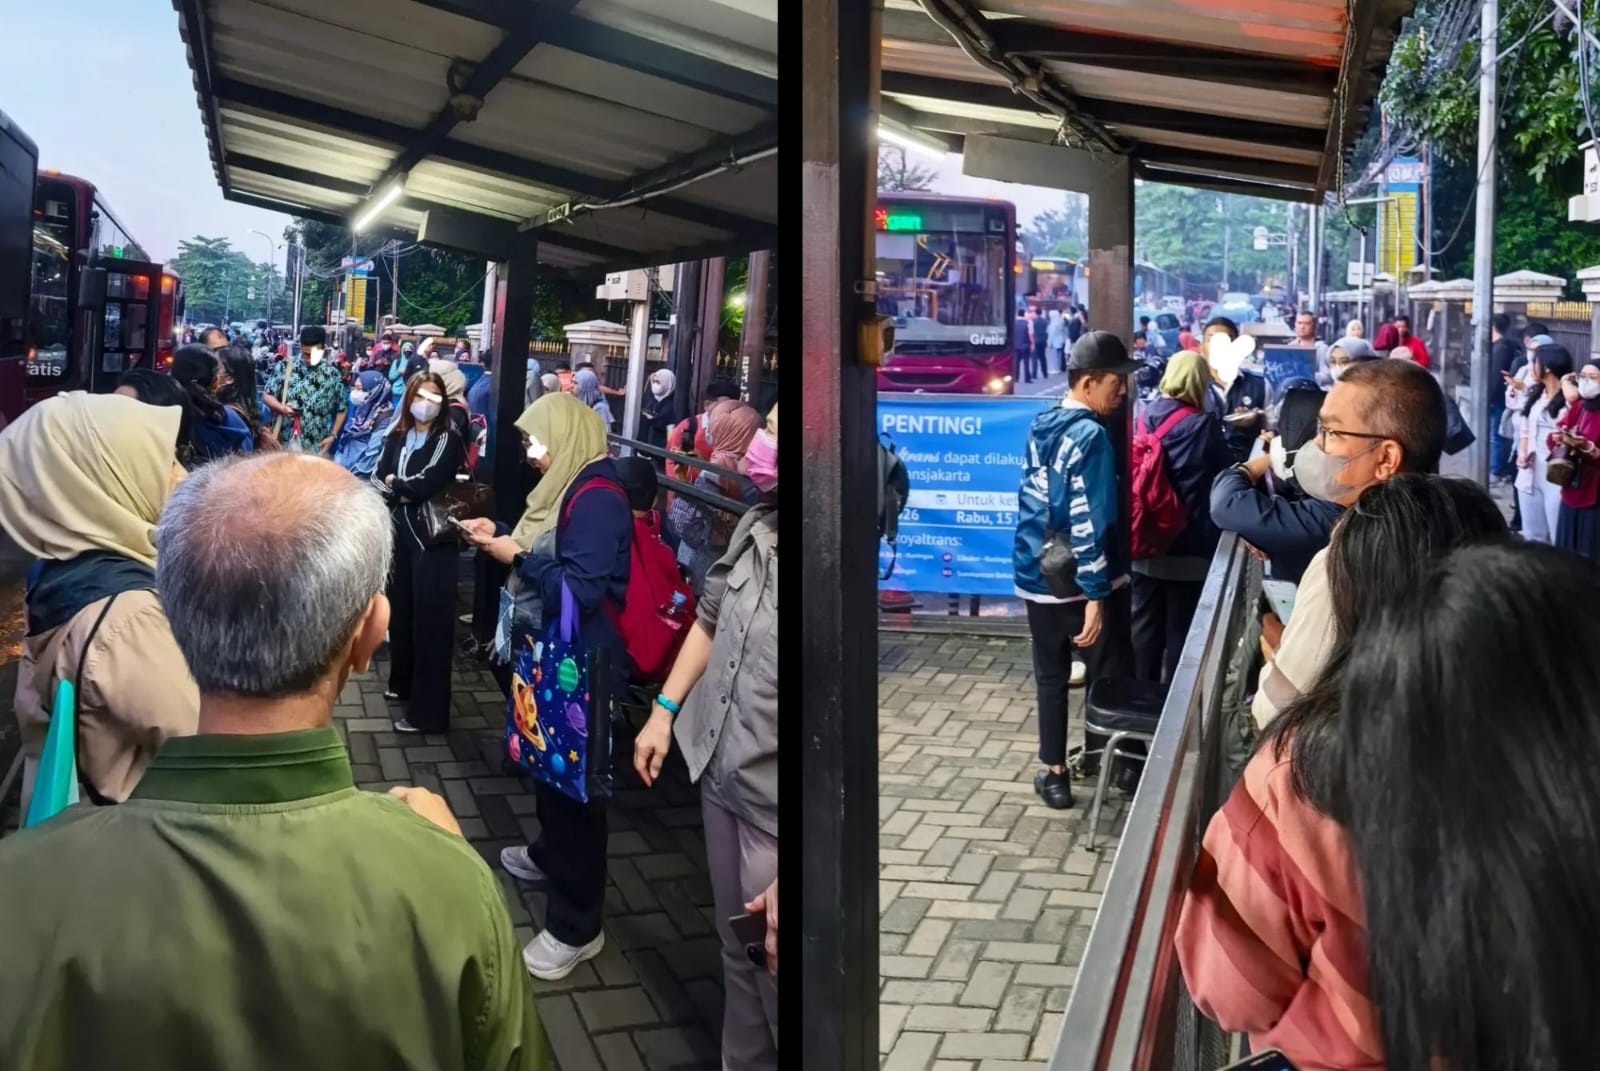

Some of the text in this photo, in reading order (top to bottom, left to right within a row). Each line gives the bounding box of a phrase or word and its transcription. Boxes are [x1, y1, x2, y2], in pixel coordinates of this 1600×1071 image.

[970, 333, 1005, 345] Gratis
[26, 362, 62, 377] atis
[882, 414, 982, 435] PENTING!
[944, 451, 980, 466] dapat
[984, 452, 1026, 465] dilaku
[957, 493, 995, 506] Untuk
[956, 511, 994, 525] Rabu,
[996, 512, 1013, 525] 15
